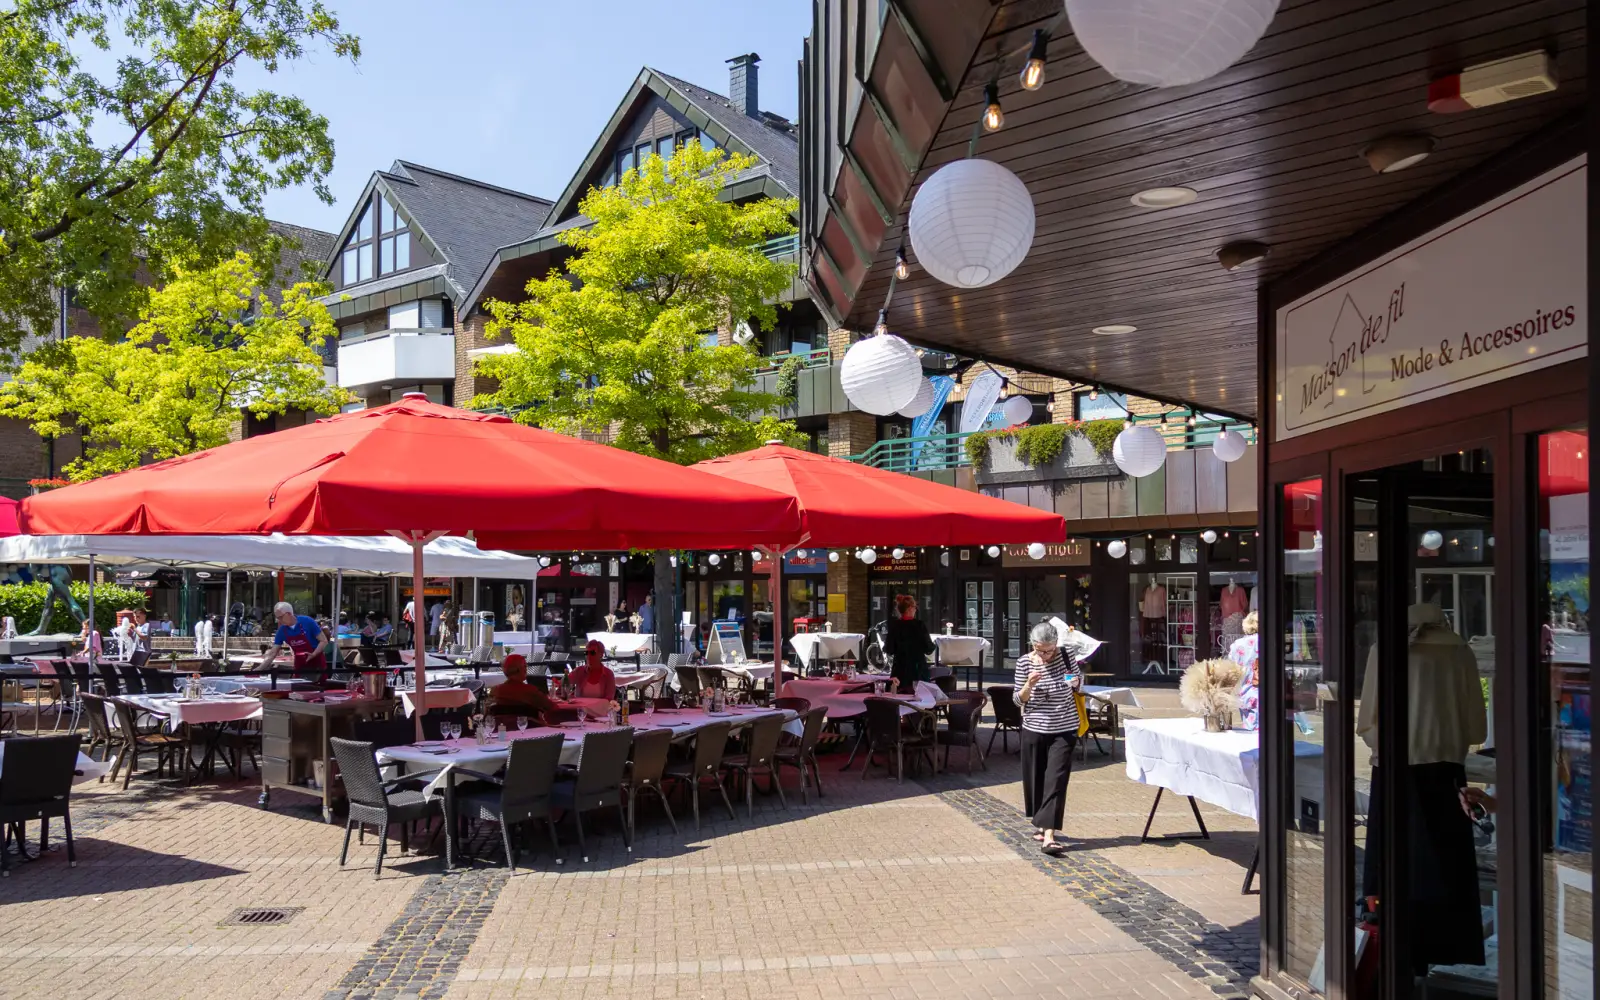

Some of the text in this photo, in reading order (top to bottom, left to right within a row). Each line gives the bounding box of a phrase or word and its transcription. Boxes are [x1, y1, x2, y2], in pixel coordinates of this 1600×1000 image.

[1299, 281, 1406, 414] Maison de fil
[1390, 304, 1576, 383] Mode & Accessoires
[1009, 544, 1082, 556] COSTIQUE
